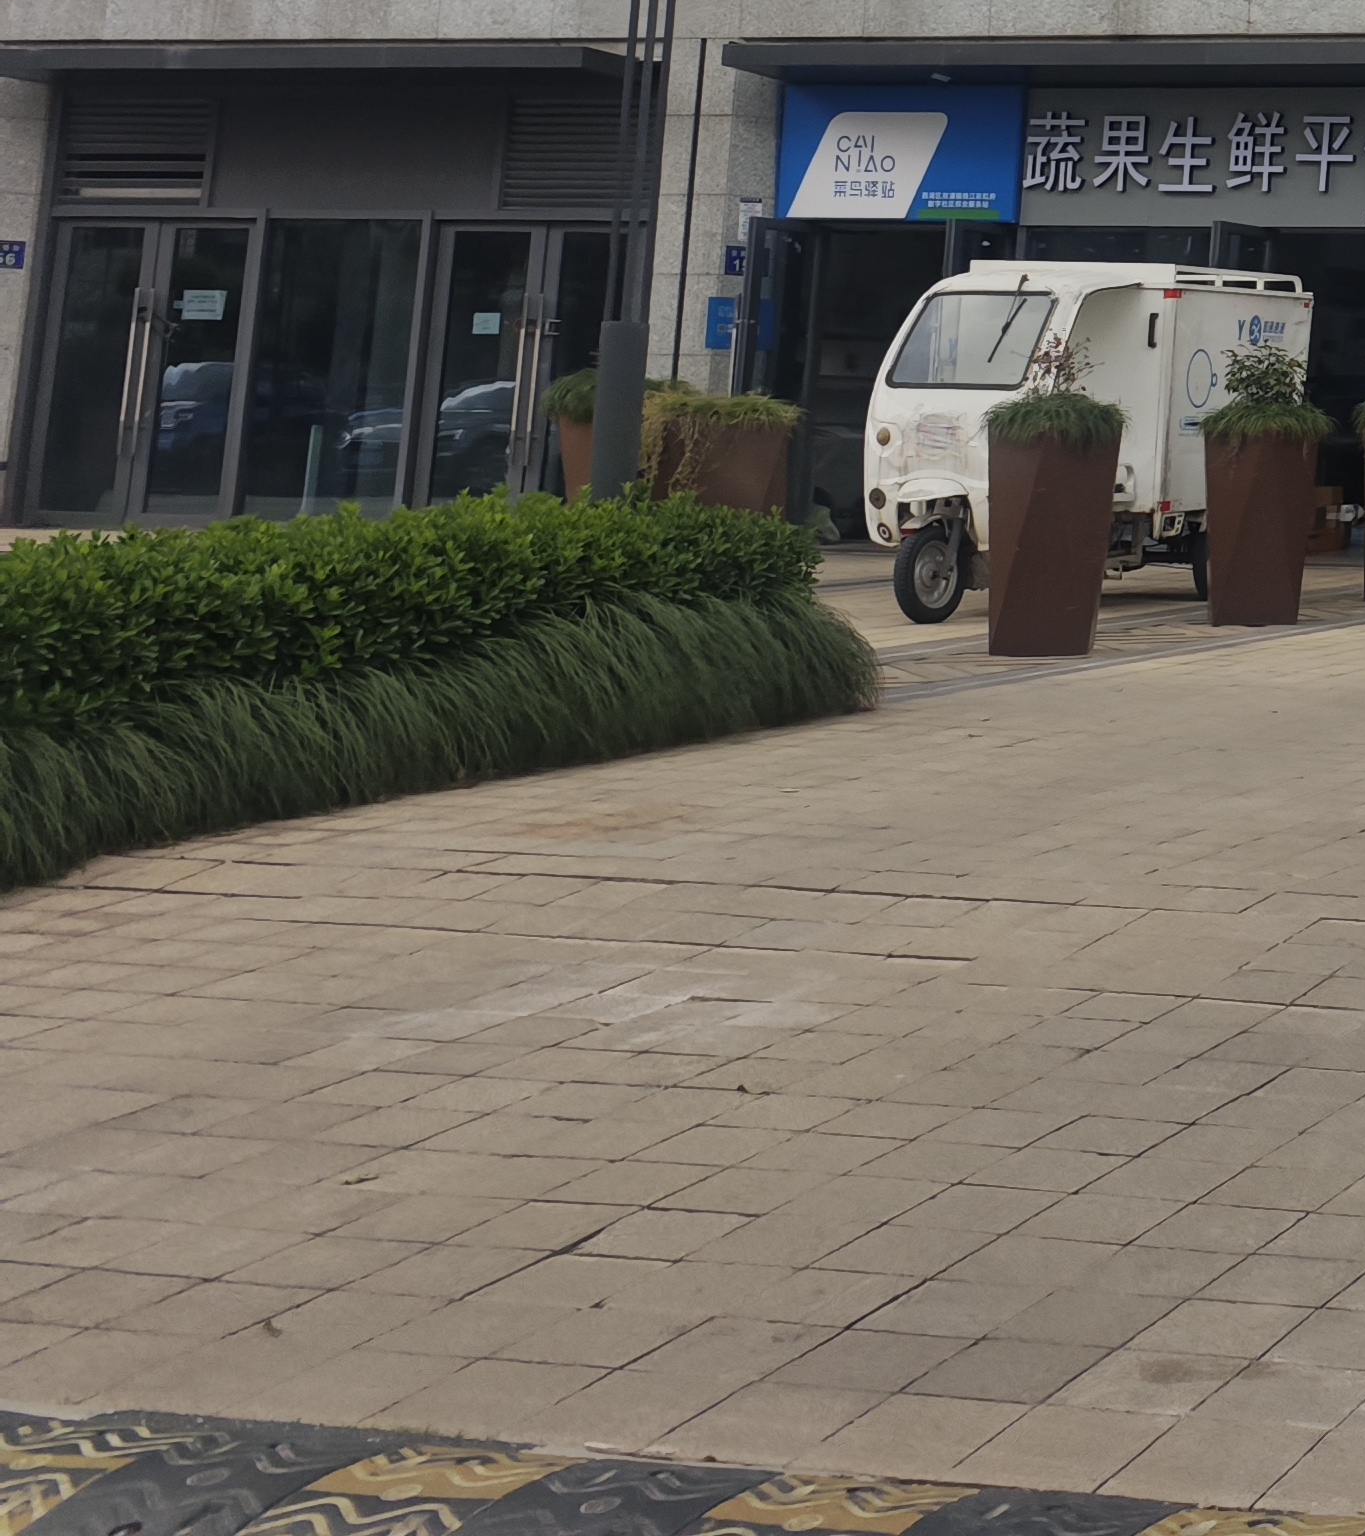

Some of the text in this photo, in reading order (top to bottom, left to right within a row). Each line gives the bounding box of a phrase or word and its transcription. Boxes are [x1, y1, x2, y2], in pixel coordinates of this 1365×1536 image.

[836, 135, 876, 153] CAI
[834, 150, 896, 173] NIAO
[833, 180, 896, 198] 菜鸟驿站
